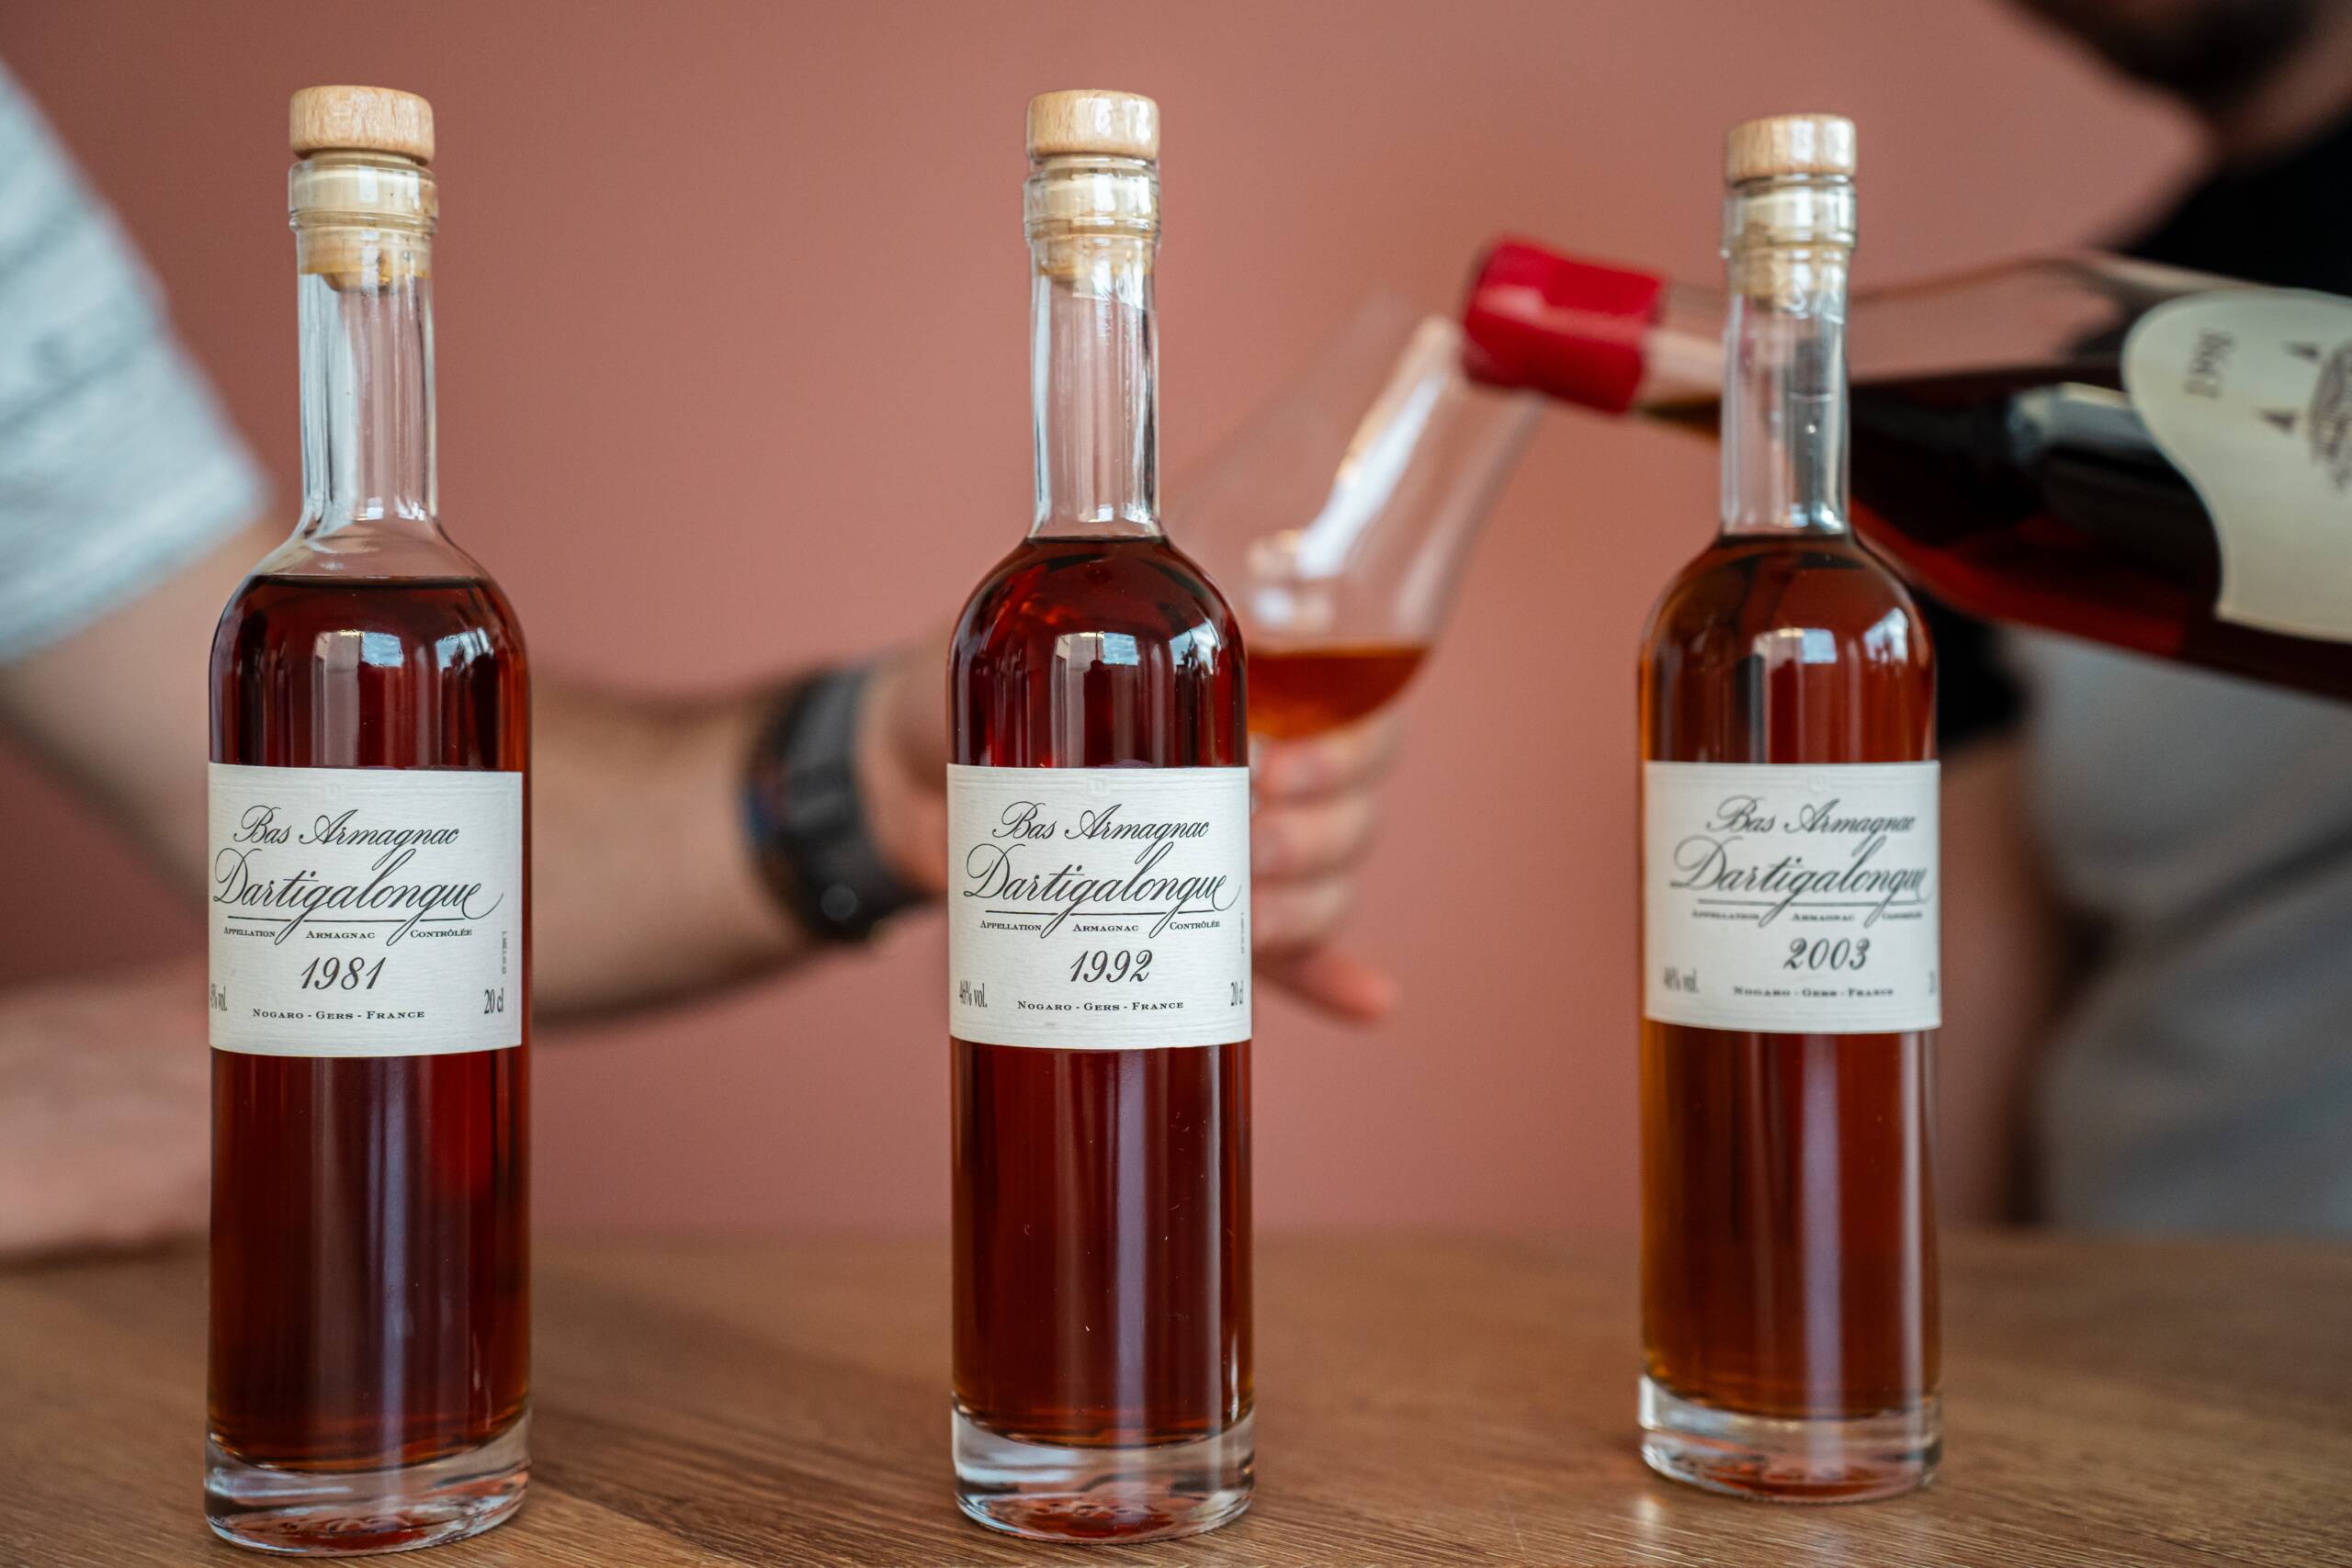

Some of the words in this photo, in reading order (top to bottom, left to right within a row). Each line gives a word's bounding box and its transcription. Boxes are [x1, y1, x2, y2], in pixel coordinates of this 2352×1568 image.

[233, 805, 292, 844] Bas
[299, 808, 460, 872] Armagnac
[991, 801, 1057, 840] Bas
[1064, 804, 1210, 864] Armagnac
[1706, 795, 1776, 831] Bas
[1784, 798, 1916, 858] Armagnac
[213, 847, 504, 946] Dartigalongue
[963, 841, 1242, 939] Dartigalongue
[1669, 834, 1933, 929] Dartigalongue
[222, 926, 277, 938] APPELLATION
[305, 930, 375, 939] ARMAGNAC
[410, 929, 473, 938] CONTRÔLÉE
[979, 919, 1042, 931] APPELLATION
[1073, 923, 1139, 932] ARMAGNAC
[1170, 919, 1220, 931] CONTRÔLÉE
[1069, 949, 1154, 983] 1992
[1782, 936, 1871, 971] 2003
[300, 956, 388, 990] 1981
[484, 989, 495, 1014] 20
[974, 982, 988, 1008] vol.
[1017, 1000, 1072, 1011] NOGARO
[1083, 1002, 1120, 1011] GERS
[1132, 1000, 1184, 1010] FRANCE
[252, 1008, 304, 1020] NOGARO
[315, 1010, 354, 1020] GERS
[367, 1010, 425, 1020] FRANCE
